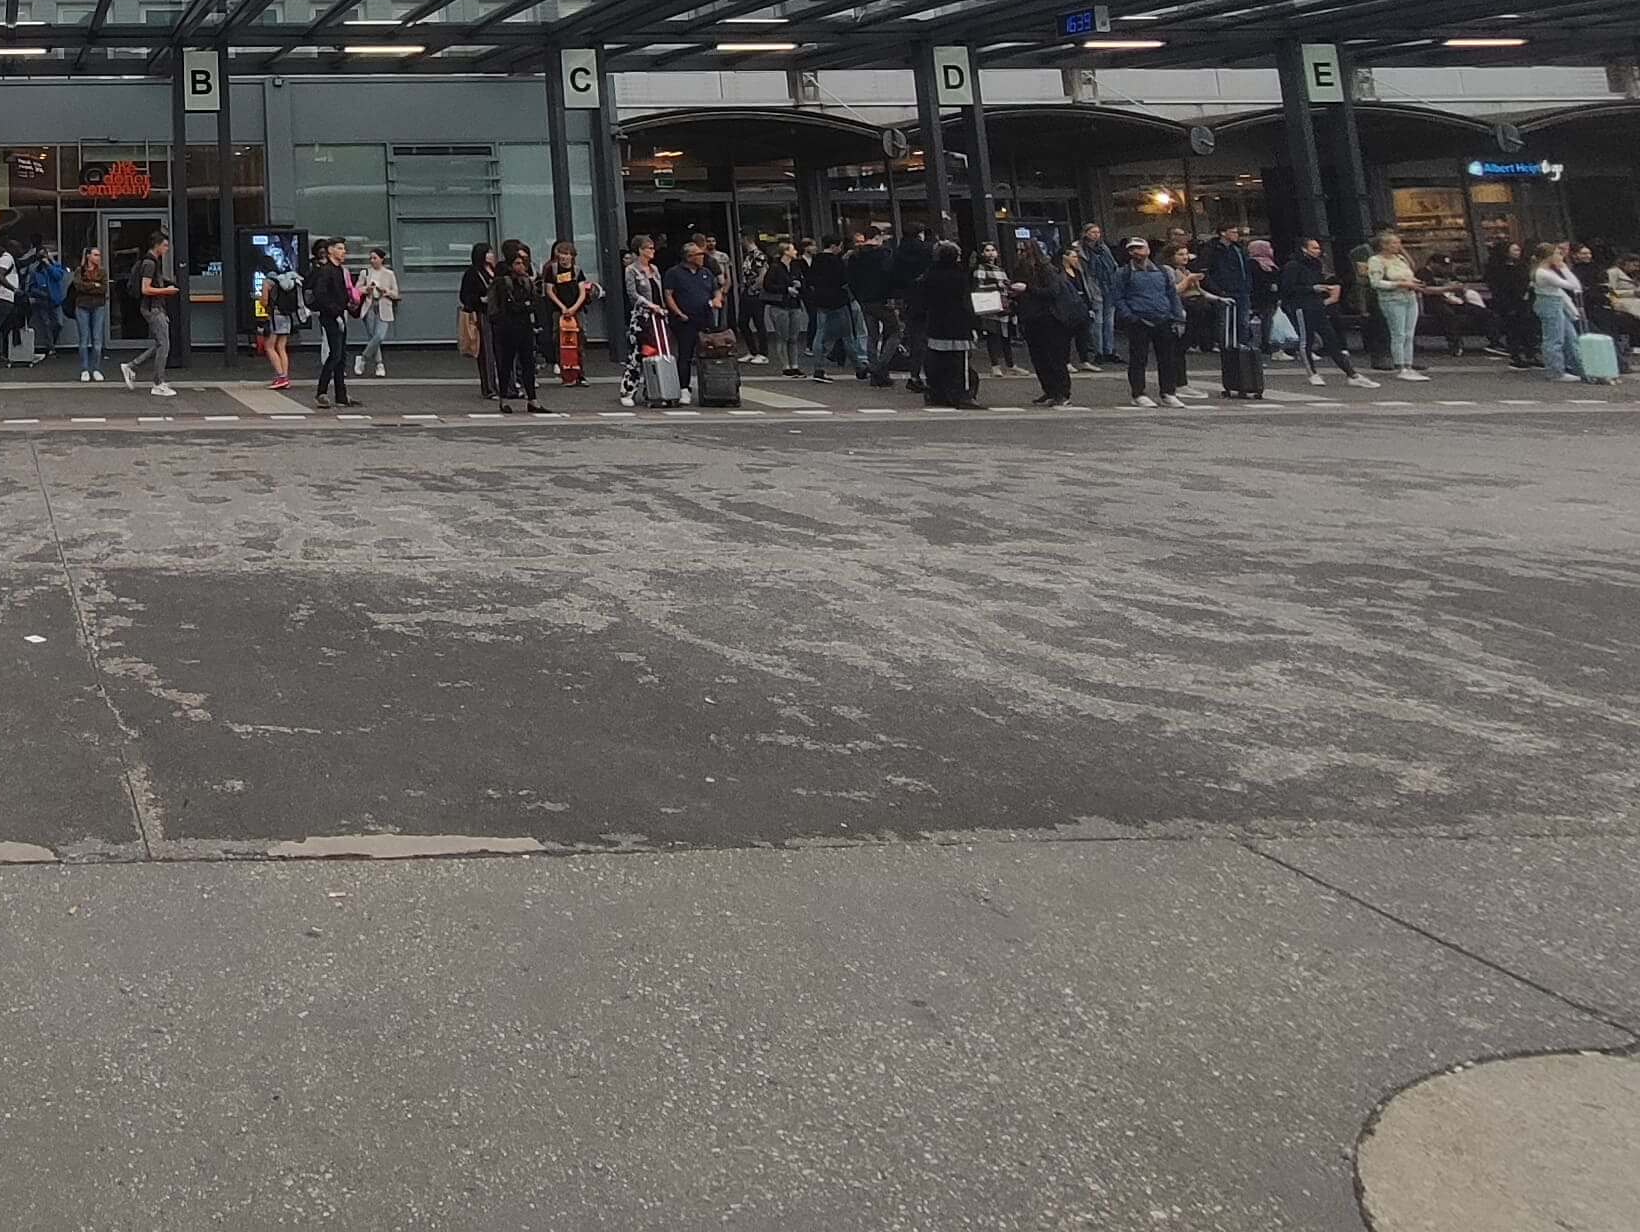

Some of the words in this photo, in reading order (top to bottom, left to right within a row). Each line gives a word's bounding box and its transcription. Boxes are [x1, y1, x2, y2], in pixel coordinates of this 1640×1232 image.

[190, 69, 213, 95] B
[569, 66, 592, 93] C
[942, 64, 965, 90] D
[1312, 62, 1335, 87] E
[78, 184, 151, 199] company
